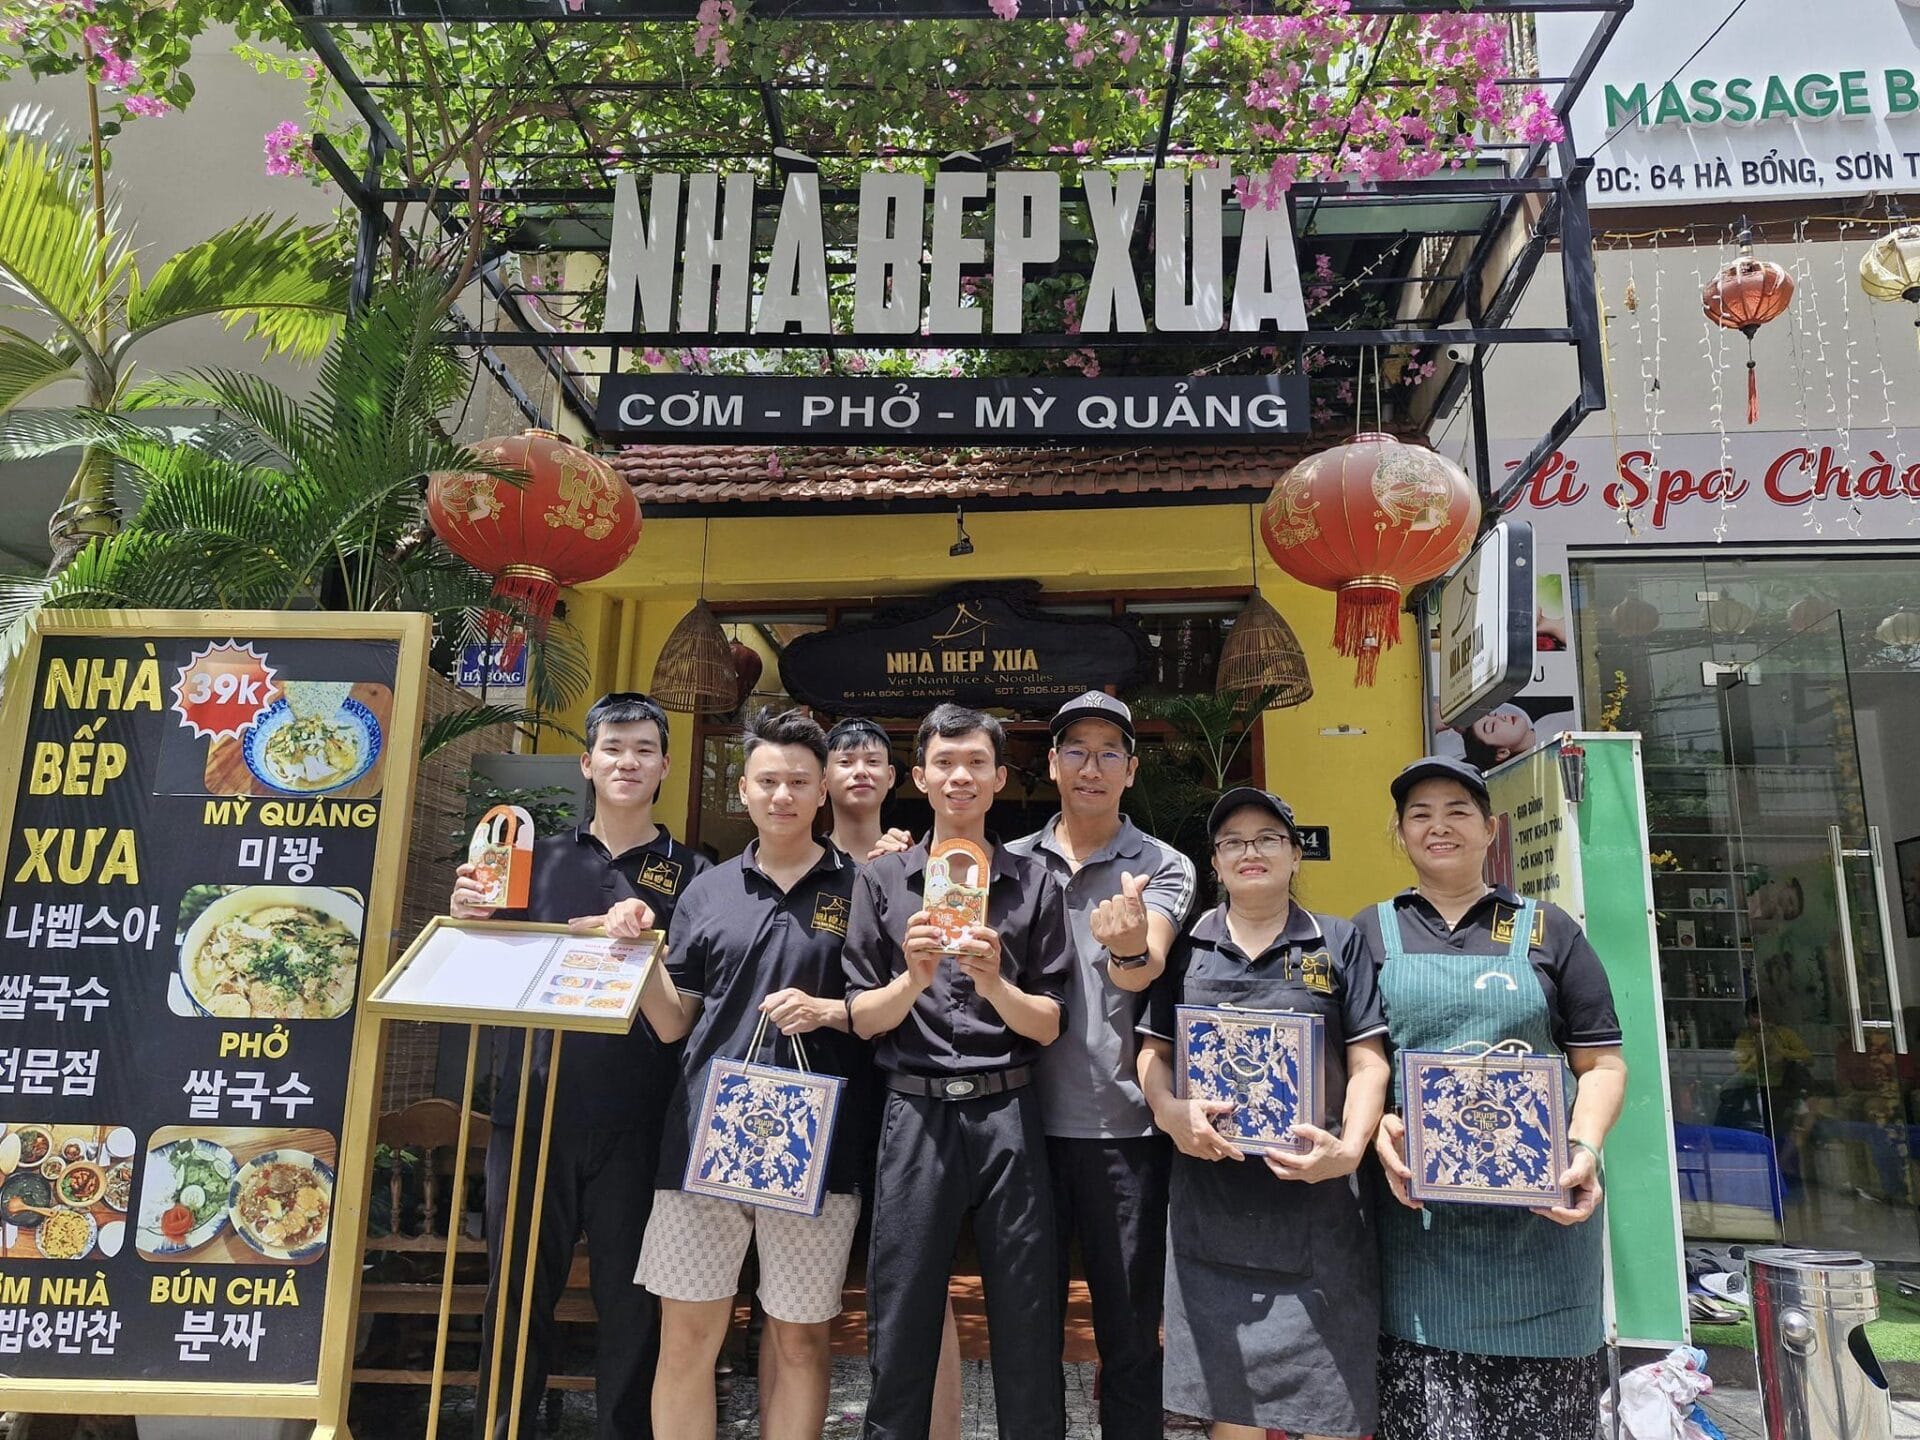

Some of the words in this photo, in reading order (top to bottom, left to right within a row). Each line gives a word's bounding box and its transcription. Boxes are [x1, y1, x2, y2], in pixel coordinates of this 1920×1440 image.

[1604, 71, 1871, 127] MASSAGE
[1884, 69, 1920, 114] B
[1597, 166, 1640, 192] ĐC:
[1650, 164, 1685, 190] 64
[1694, 156, 1732, 188] HÀ
[1742, 148, 1825, 188] BỔNG,
[1835, 152, 1893, 181] SƠN
[604, 146, 833, 334] NHÀ
[854, 137, 1061, 334] BẾP
[1080, 158, 1310, 333] XƯA
[618, 390, 744, 427] CƠM
[801, 383, 921, 428] PHỞ
[975, 387, 1057, 428] MỲ
[1077, 382, 1288, 430] QUẢNG
[1603, 450, 1750, 528] Spa
[43, 643, 163, 712] NHÀ
[188, 672, 262, 706] 39k
[953, 674, 979, 684] Rice
[28, 718, 128, 796] BẾP
[203, 794, 252, 826] MỲ
[259, 794, 378, 829] QUẢNG
[14, 827, 141, 885] XƯA
[238, 836, 324, 884] 미꽝
[5, 902, 162, 951] 냐벱스아
[0, 974, 111, 1022] 쌀국수
[219, 1024, 290, 1060] PHỞ
[183, 1070, 314, 1121] 쌀국수
[39, 1270, 110, 1307] NHÀ
[150, 1269, 216, 1306] BÚN
[227, 1269, 300, 1307] CHẢ
[175, 1311, 266, 1363] 분짜
